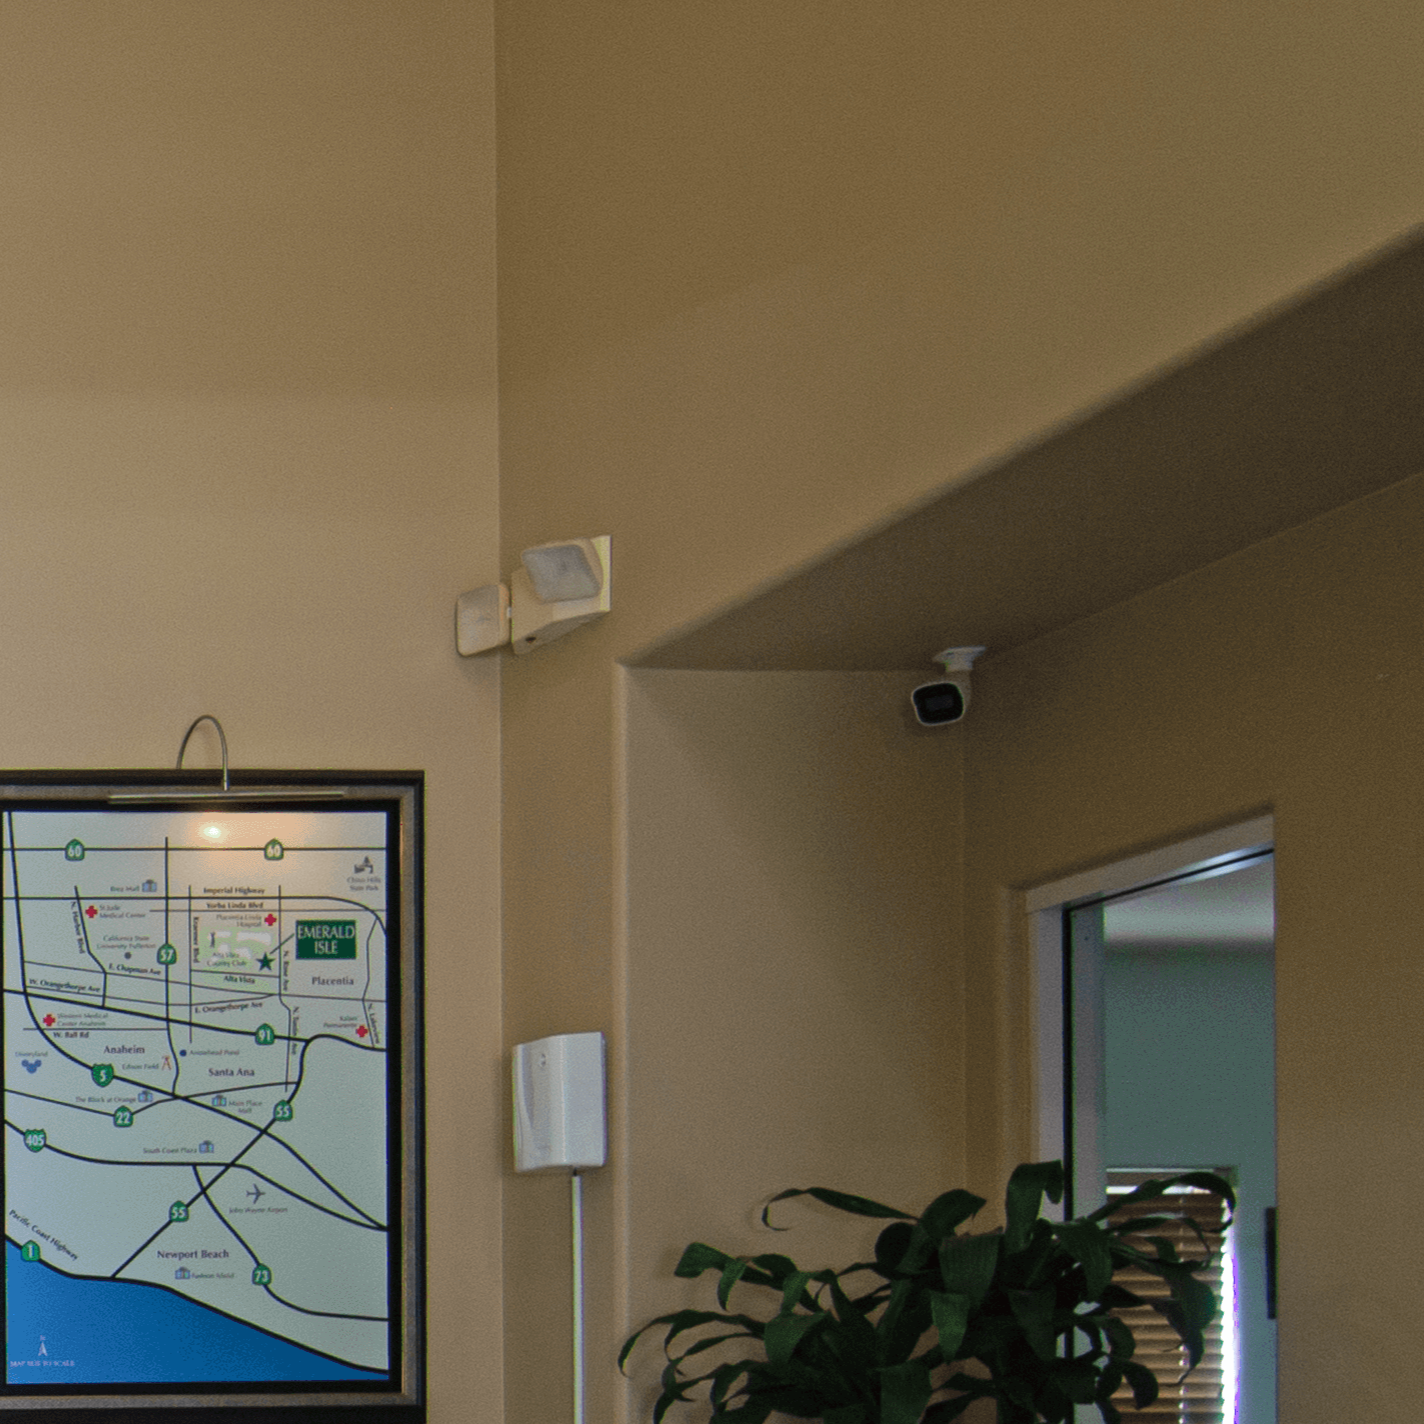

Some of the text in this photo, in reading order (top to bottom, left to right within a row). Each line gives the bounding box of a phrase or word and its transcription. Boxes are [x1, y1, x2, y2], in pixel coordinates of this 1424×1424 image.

[68, 846, 83, 857] 60
[267, 844, 280, 857] 60
[203, 887, 265, 896] Imperial Highway
[297, 925, 355, 939] EMERALD
[314, 941, 339, 955] ISLE
[160, 949, 174, 961] 57
[312, 977, 354, 986] Placentia
[259, 1029, 272, 1042] 91
[103, 1045, 145, 1054] Anaheim
[100, 1069, 107, 1082] 5
[208, 1067, 255, 1077] Santa Ana
[276, 1106, 290, 1117] 55
[116, 1113, 131, 1124] 22
[26, 1135, 45, 1146] 405
[172, 1207, 186, 1218] 55
[9, 1209, 78, 1261] Pacific Coast Highway
[157, 1249, 229, 1261] Newport Beach
[254, 1270, 269, 1282] 73
